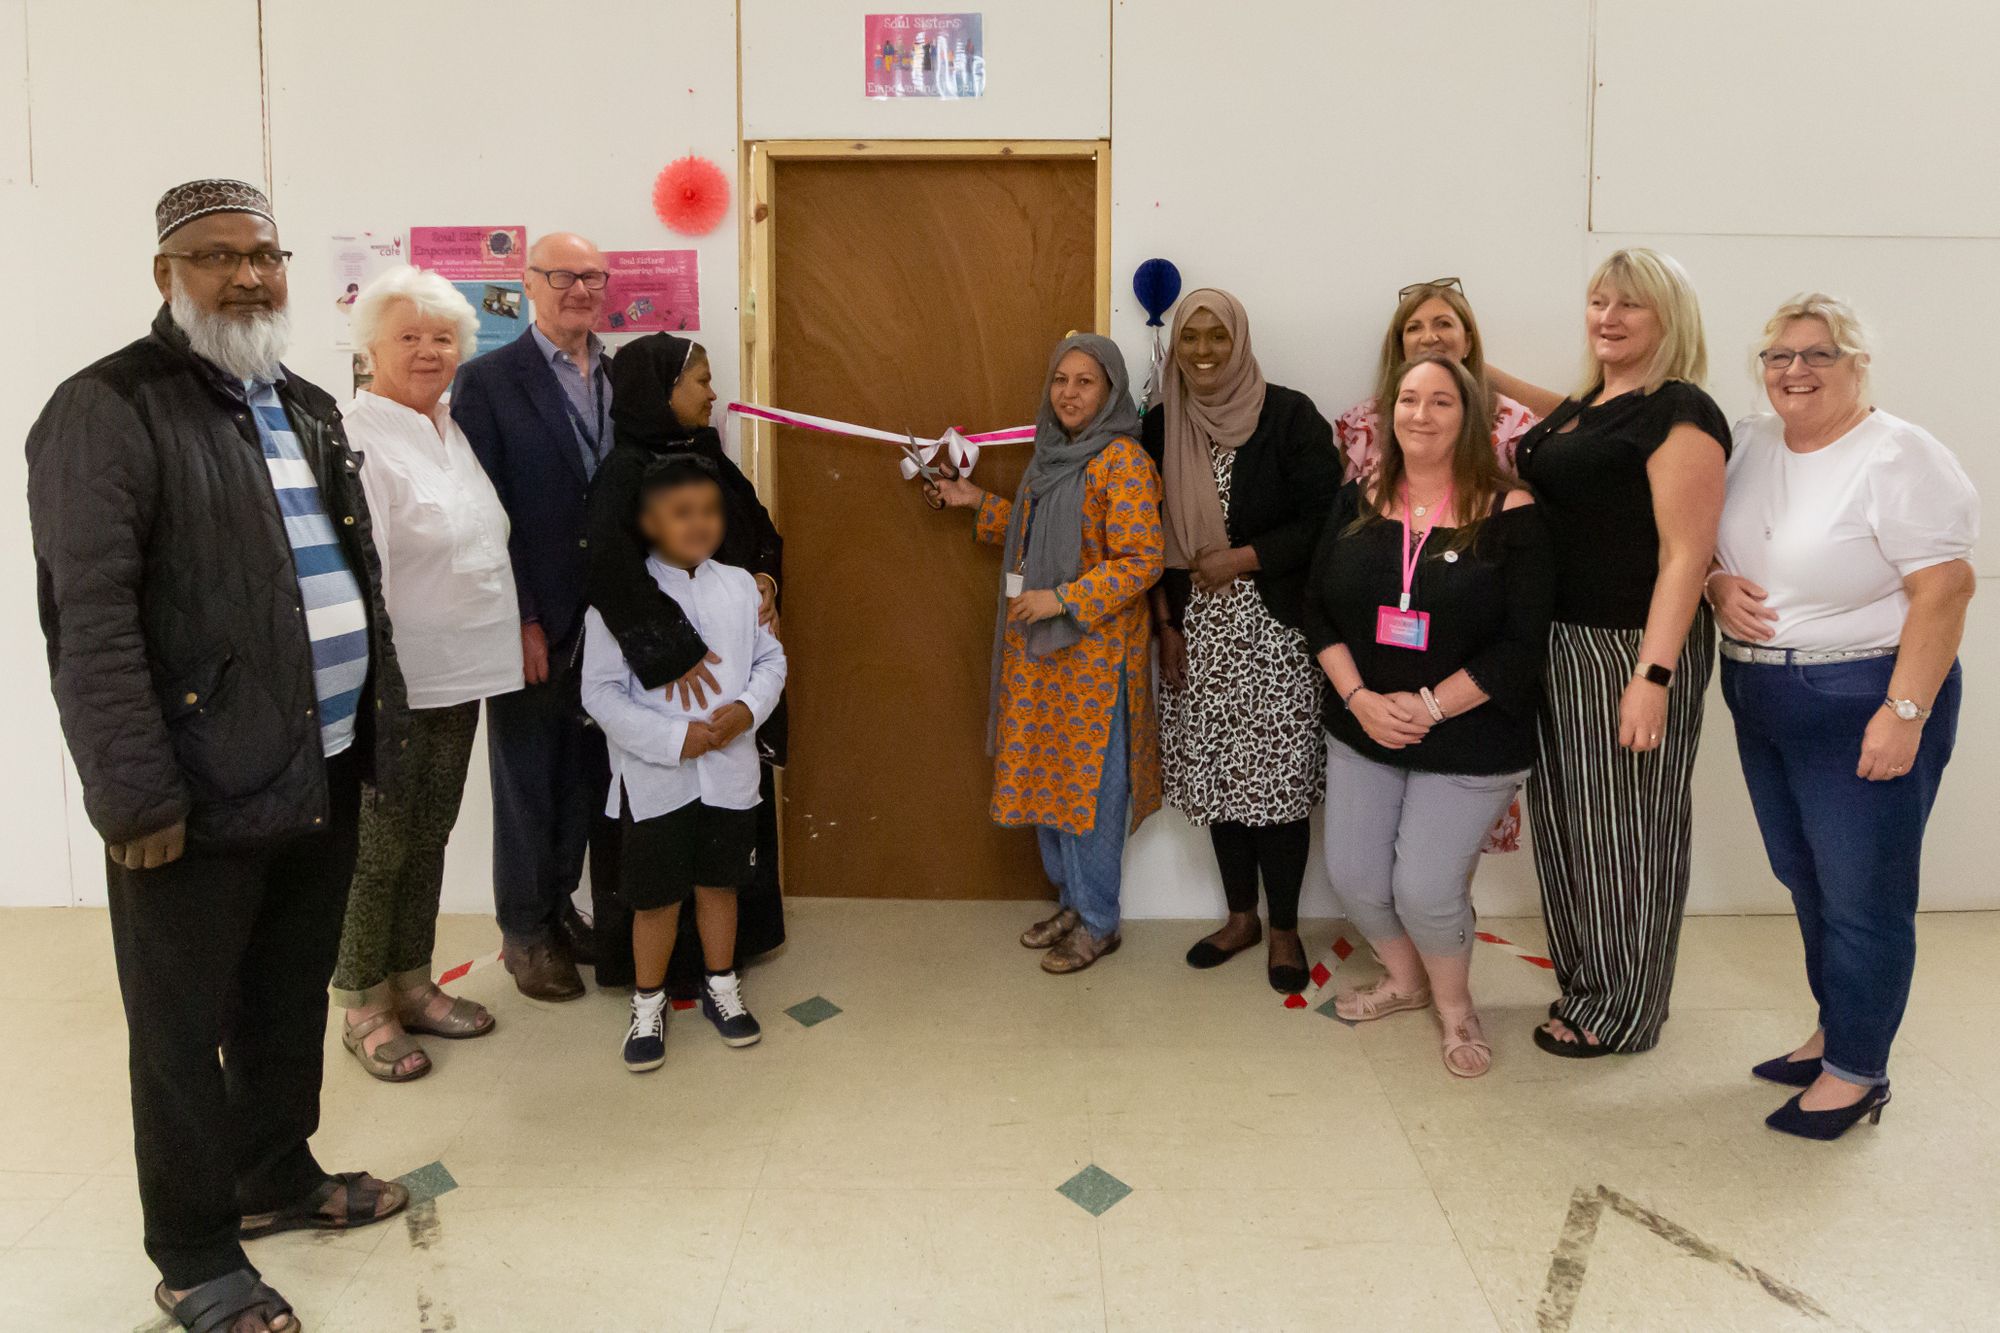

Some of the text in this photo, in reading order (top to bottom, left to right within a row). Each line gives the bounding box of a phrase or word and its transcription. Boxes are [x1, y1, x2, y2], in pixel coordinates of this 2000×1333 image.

[884, 17, 961, 29] Soul Sisters
[432, 232, 456, 242] Soul
[414, 245, 481, 259] Empowering
